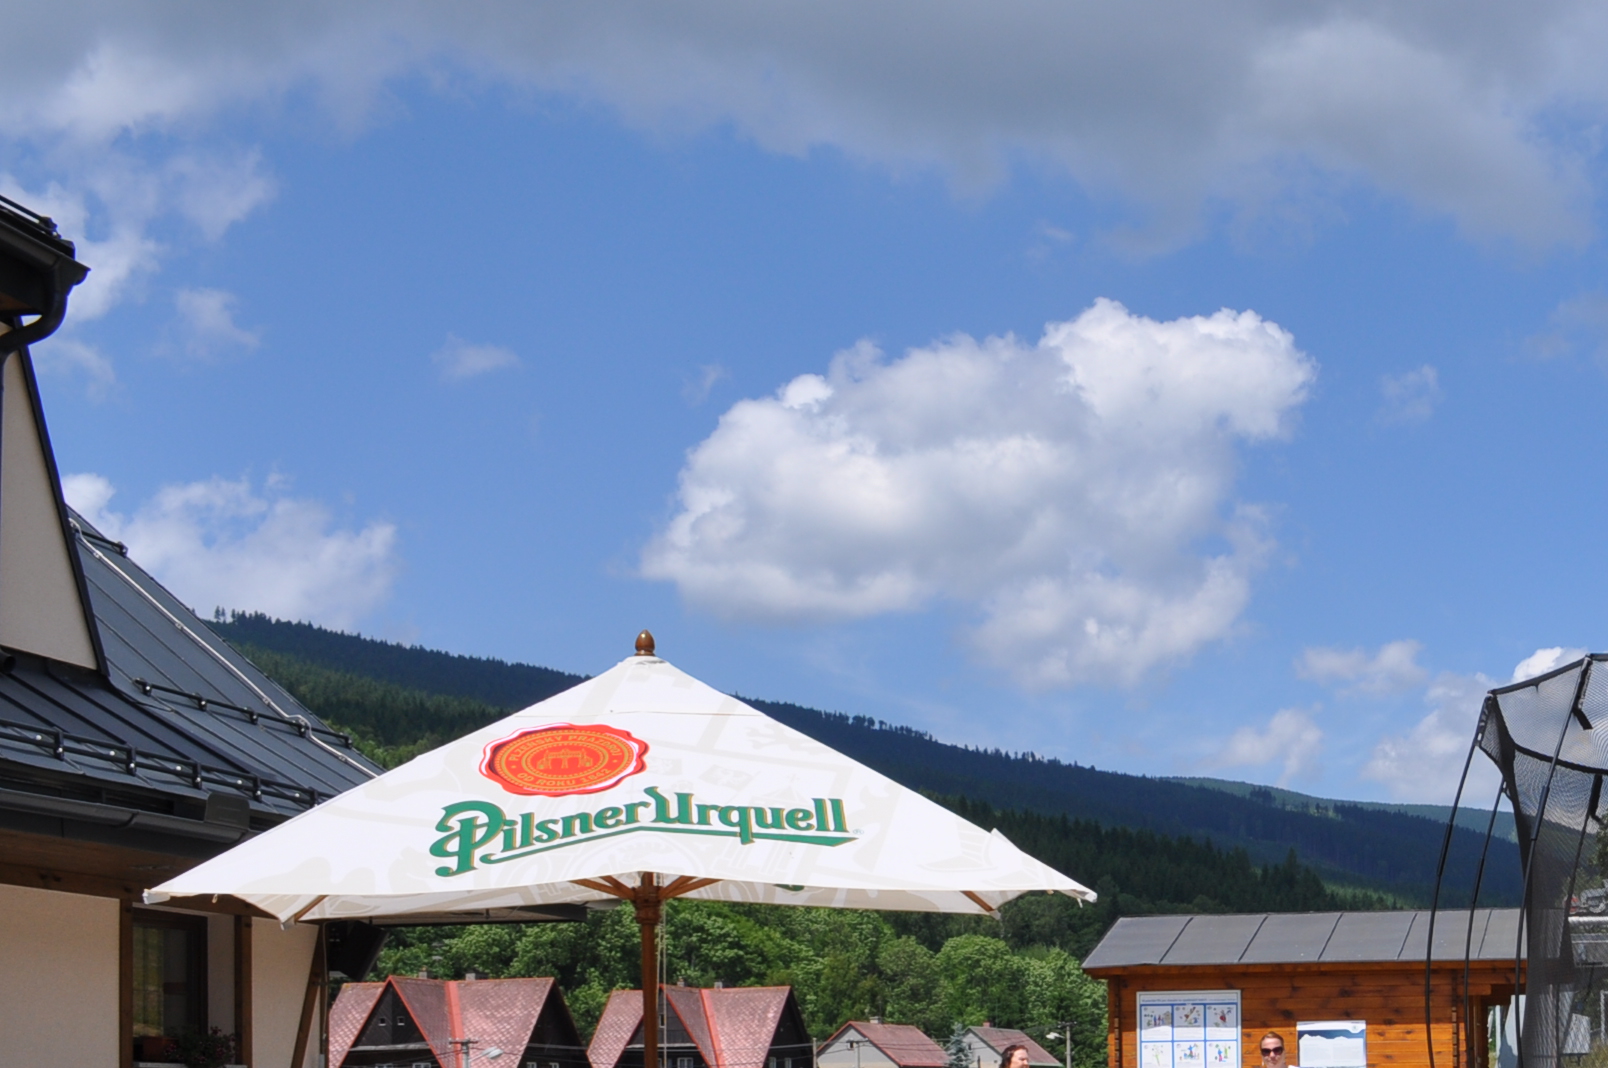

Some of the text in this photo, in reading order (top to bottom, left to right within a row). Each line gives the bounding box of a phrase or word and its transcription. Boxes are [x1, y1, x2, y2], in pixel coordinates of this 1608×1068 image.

[517, 768, 612, 787] OD ROKU 1842
[429, 786, 849, 877] Pilsner Urquell
